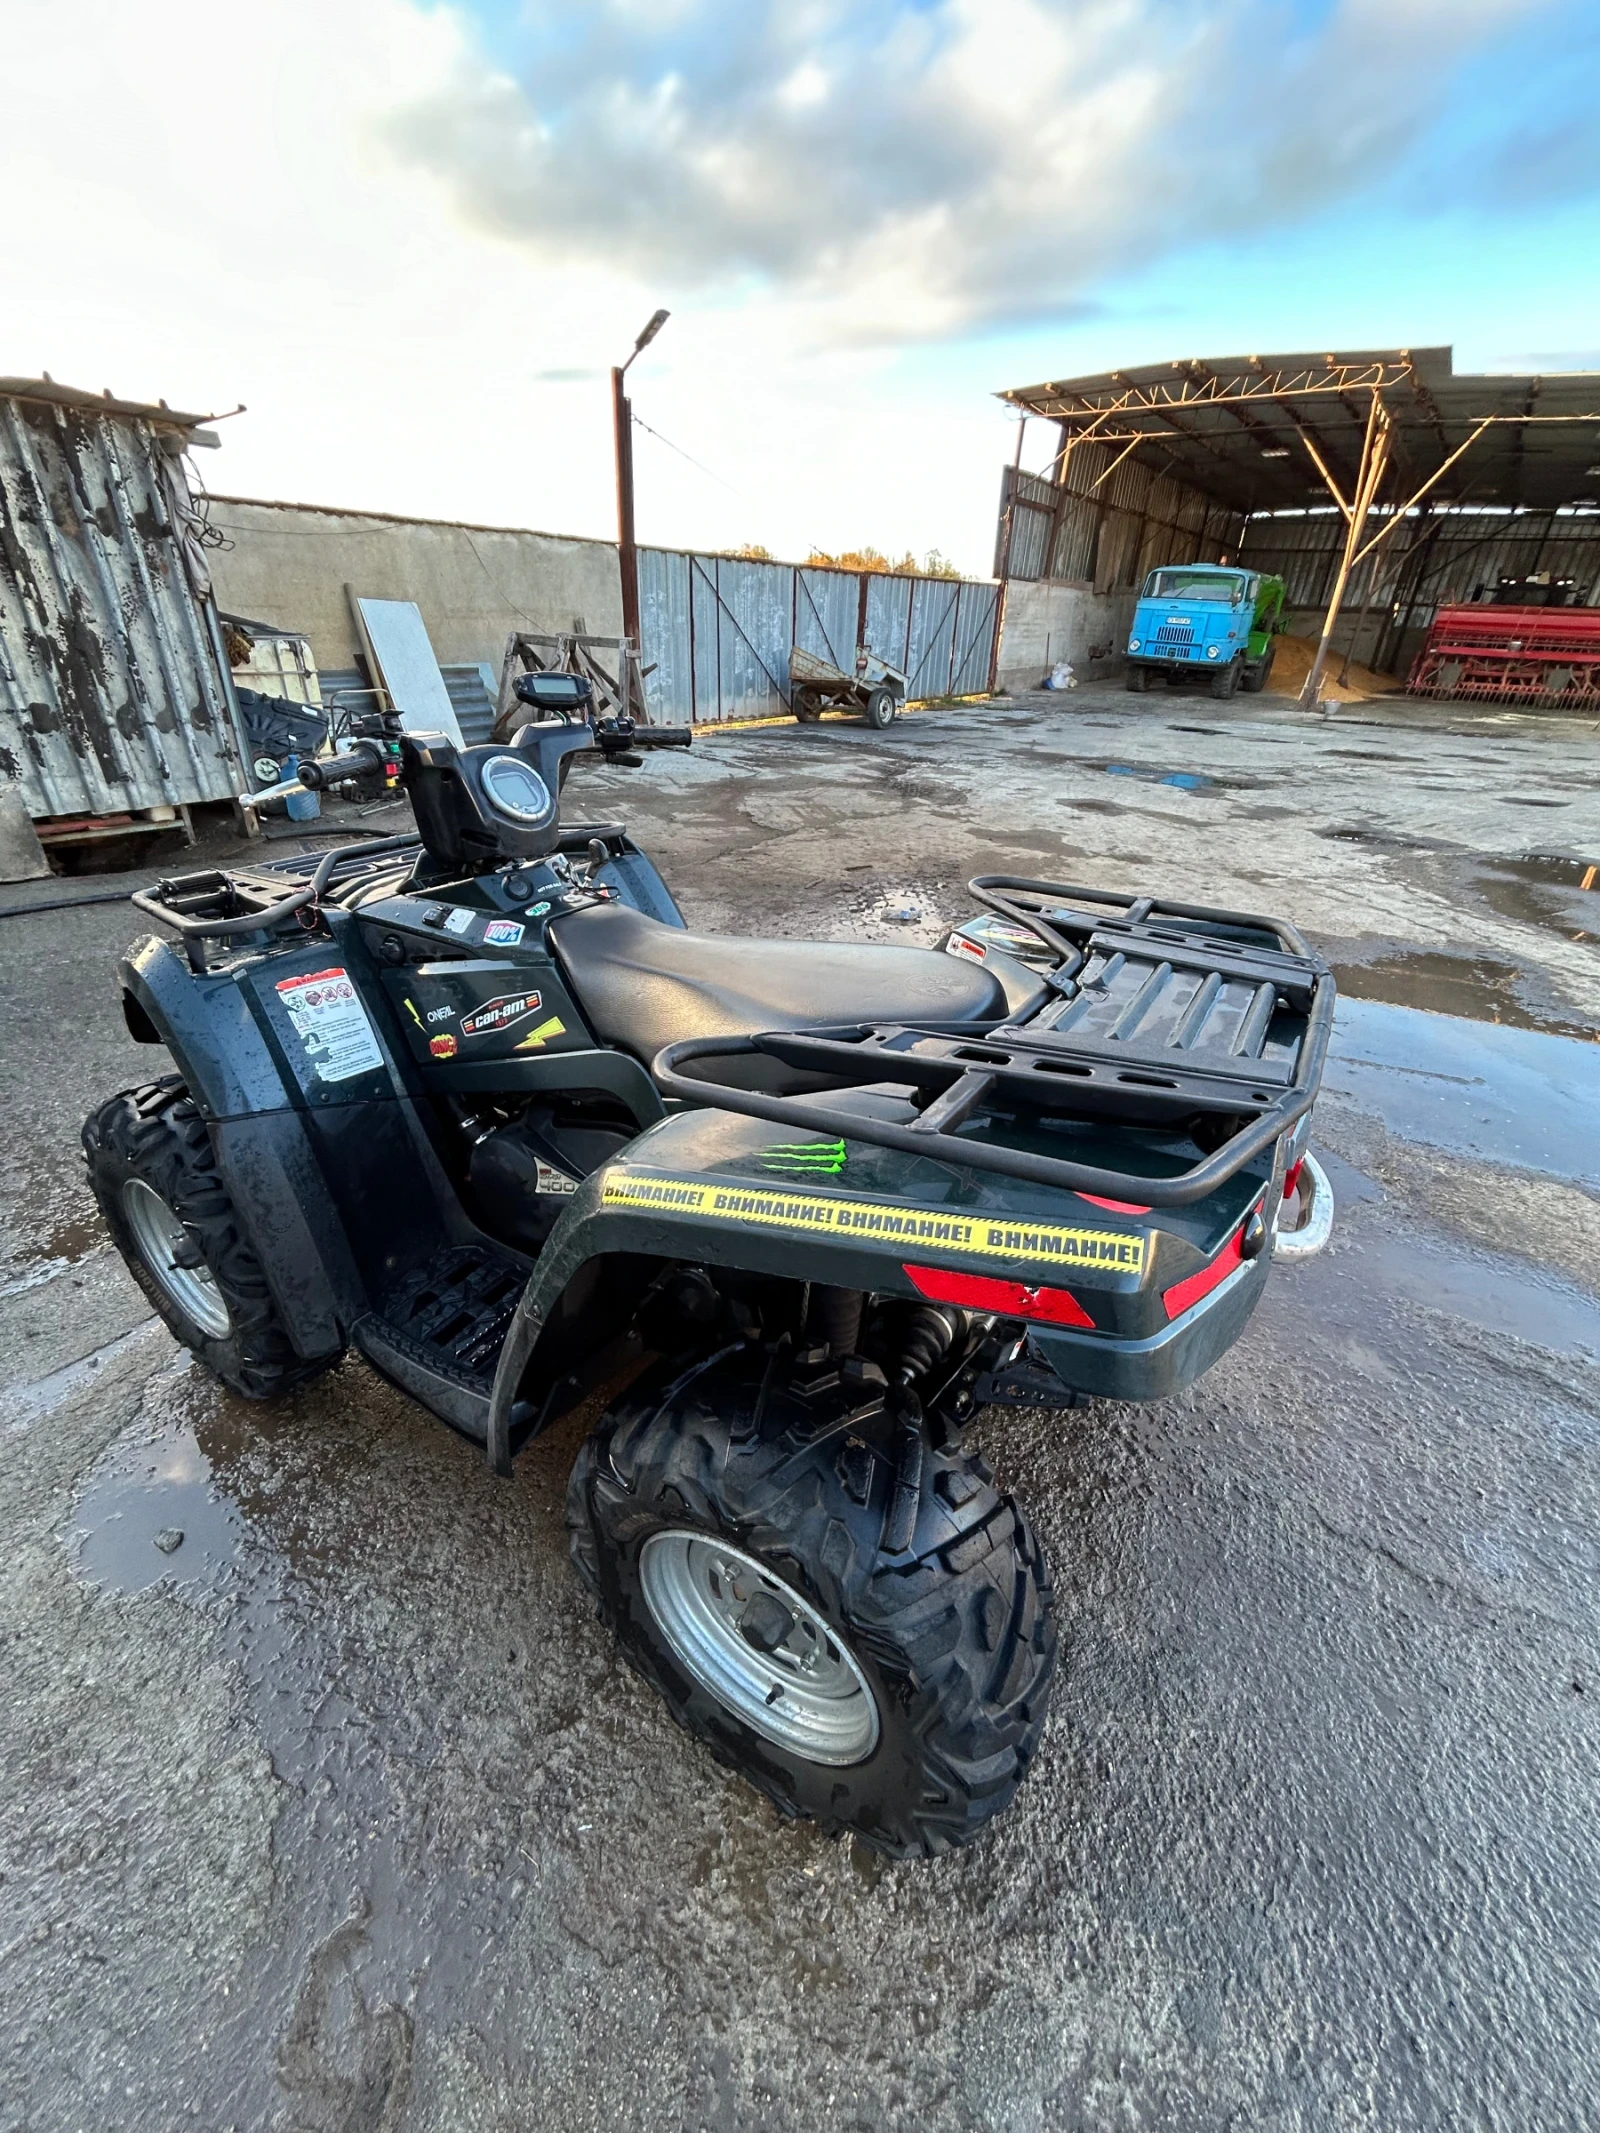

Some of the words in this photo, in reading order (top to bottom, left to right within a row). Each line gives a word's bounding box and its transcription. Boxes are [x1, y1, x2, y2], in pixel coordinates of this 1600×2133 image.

[487, 924, 520, 941] 100%
[475, 999, 526, 1028] can-am
[714, 1193, 833, 1223] ВНИМАНИЕ!
[836, 1209, 972, 1243] ВНИМАНИЕ!
[986, 1228, 1141, 1264] ВНИМАНИЕ!
